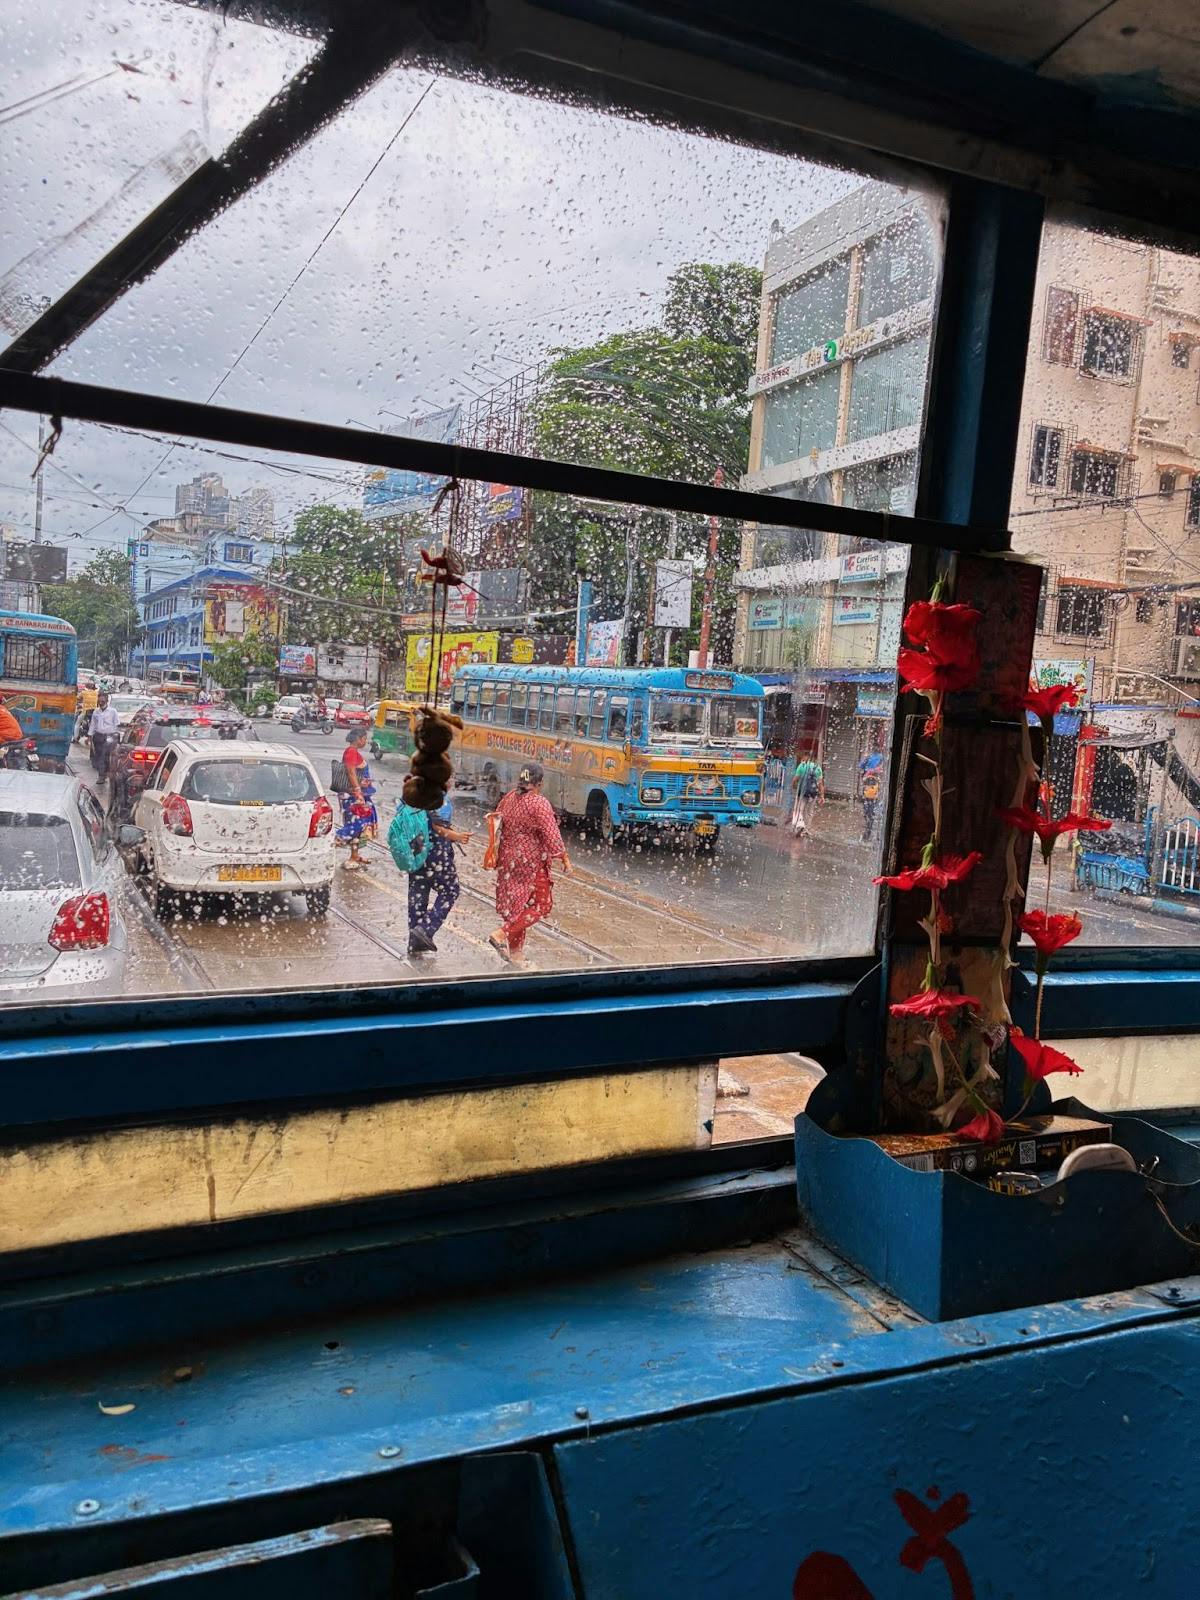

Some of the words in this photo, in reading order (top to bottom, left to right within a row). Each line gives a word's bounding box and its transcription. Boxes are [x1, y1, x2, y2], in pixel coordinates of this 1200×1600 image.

[856, 555, 879, 564] CareFirst
[855, 564, 870, 572] Clinic
[736, 720, 757, 736] 223
